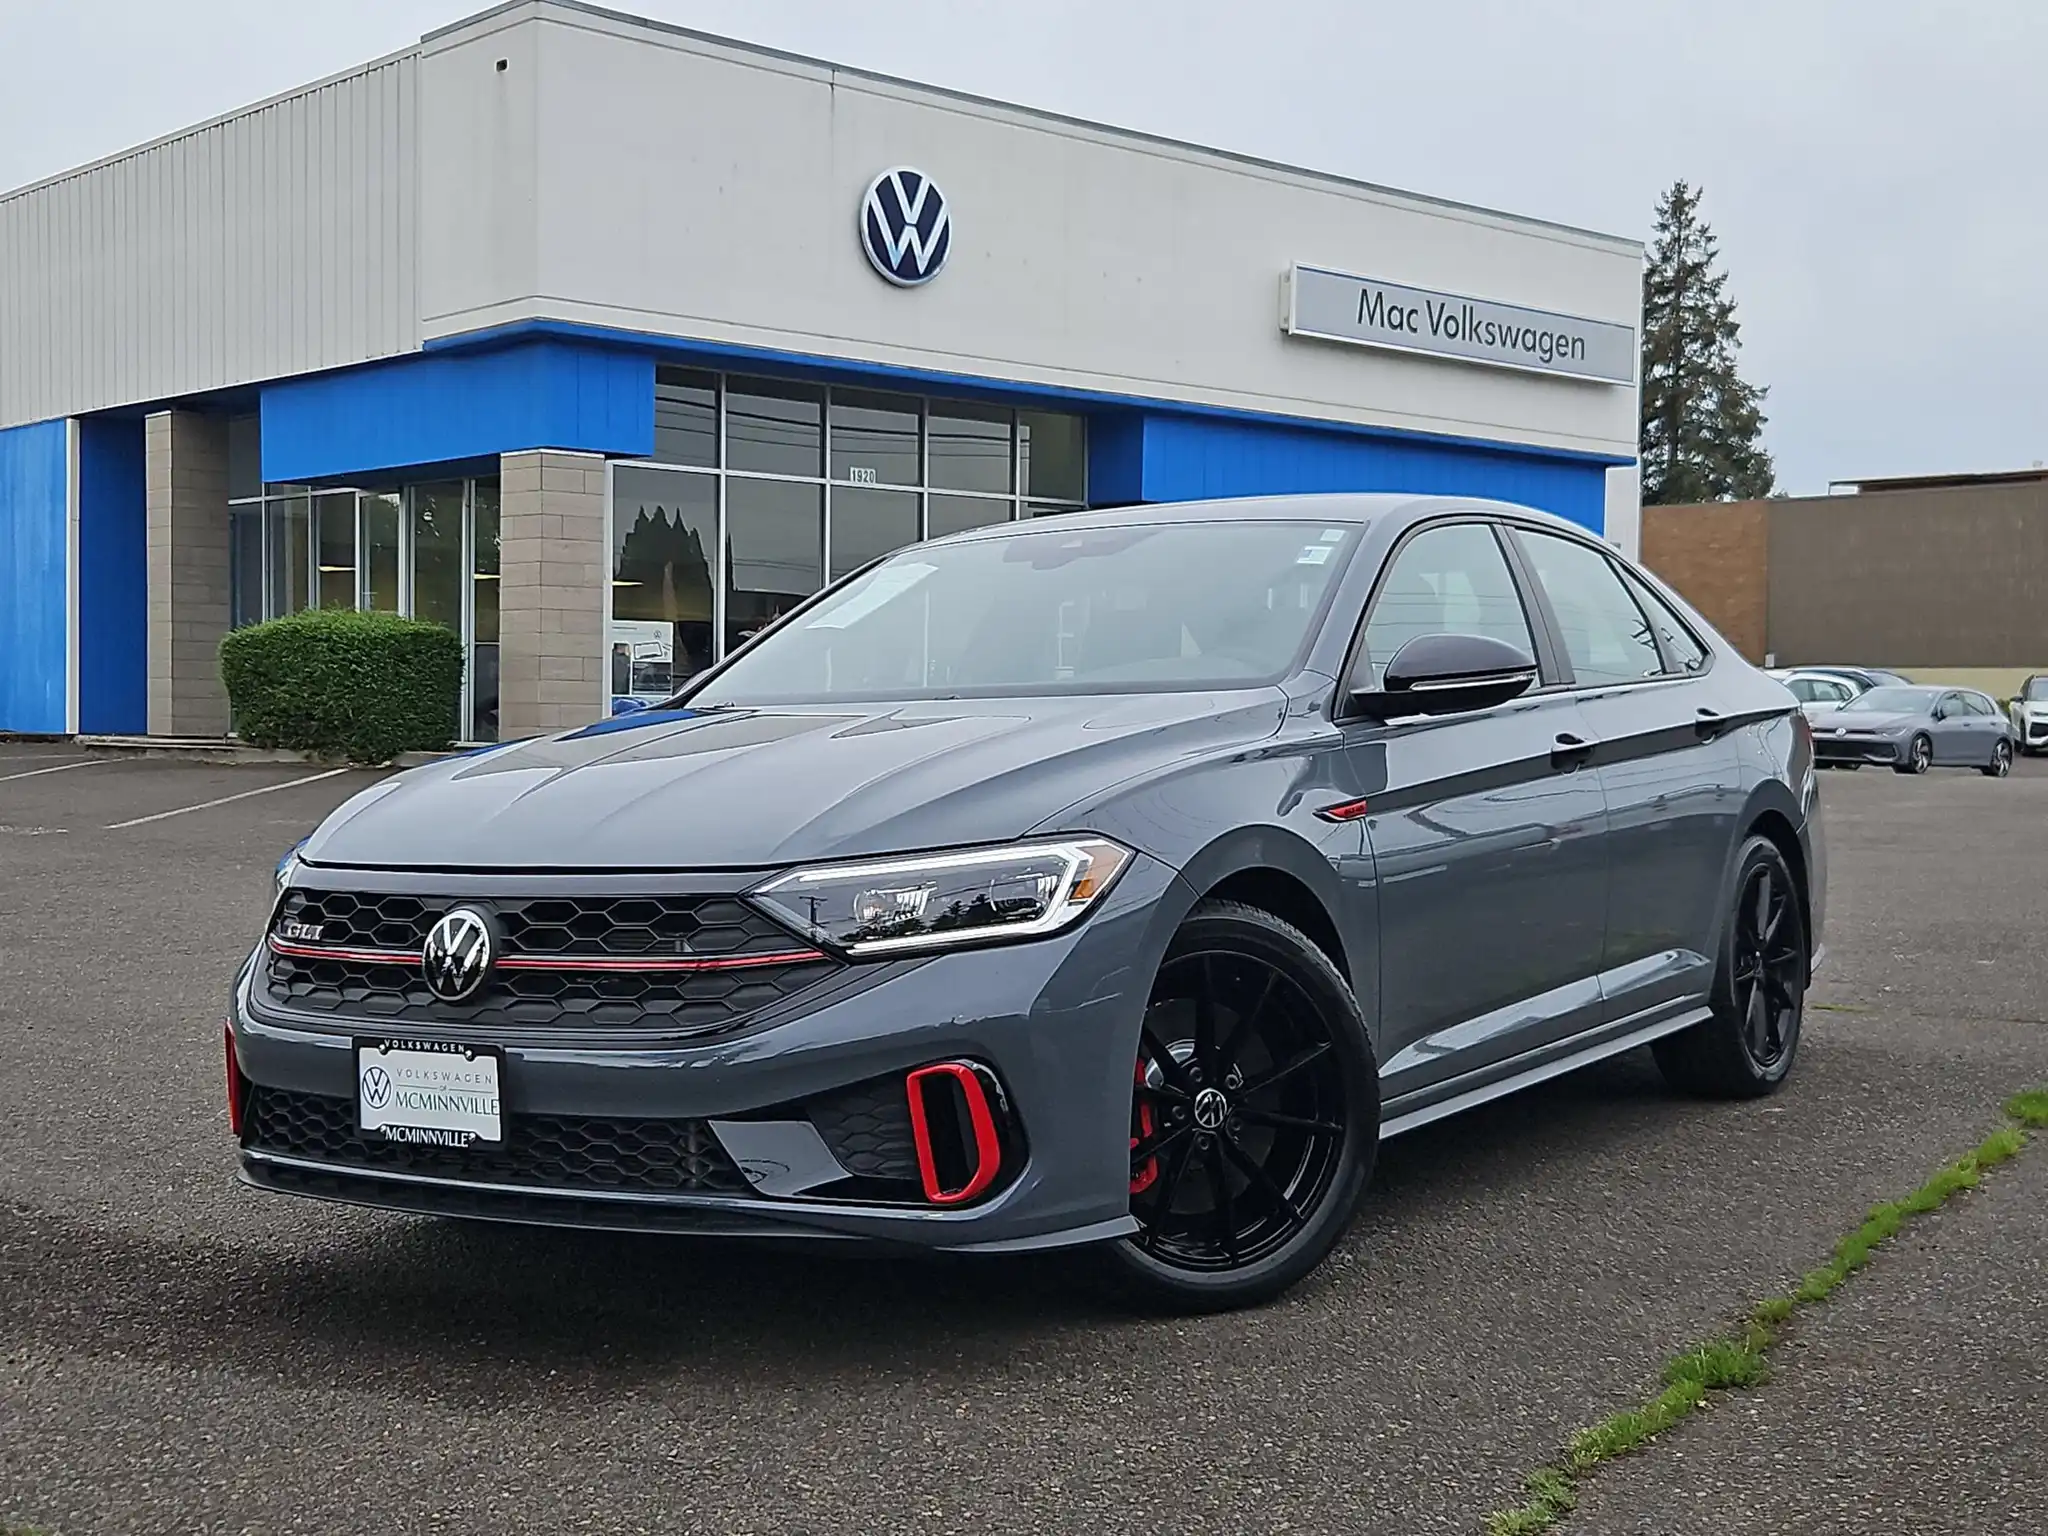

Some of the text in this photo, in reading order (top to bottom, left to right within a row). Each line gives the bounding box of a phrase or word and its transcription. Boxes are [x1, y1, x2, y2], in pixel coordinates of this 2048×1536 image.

[861, 166, 952, 287] VW
[1357, 288, 1585, 364] Mac Volkswagen
[852, 469, 875, 483] 1920
[384, 1039, 465, 1053] VOLKSWAGEN
[396, 1068, 493, 1085] VOLKSWAGEN
[395, 1091, 500, 1116] MCMINNVILLE
[385, 1126, 469, 1147] MCMINNVILLE
